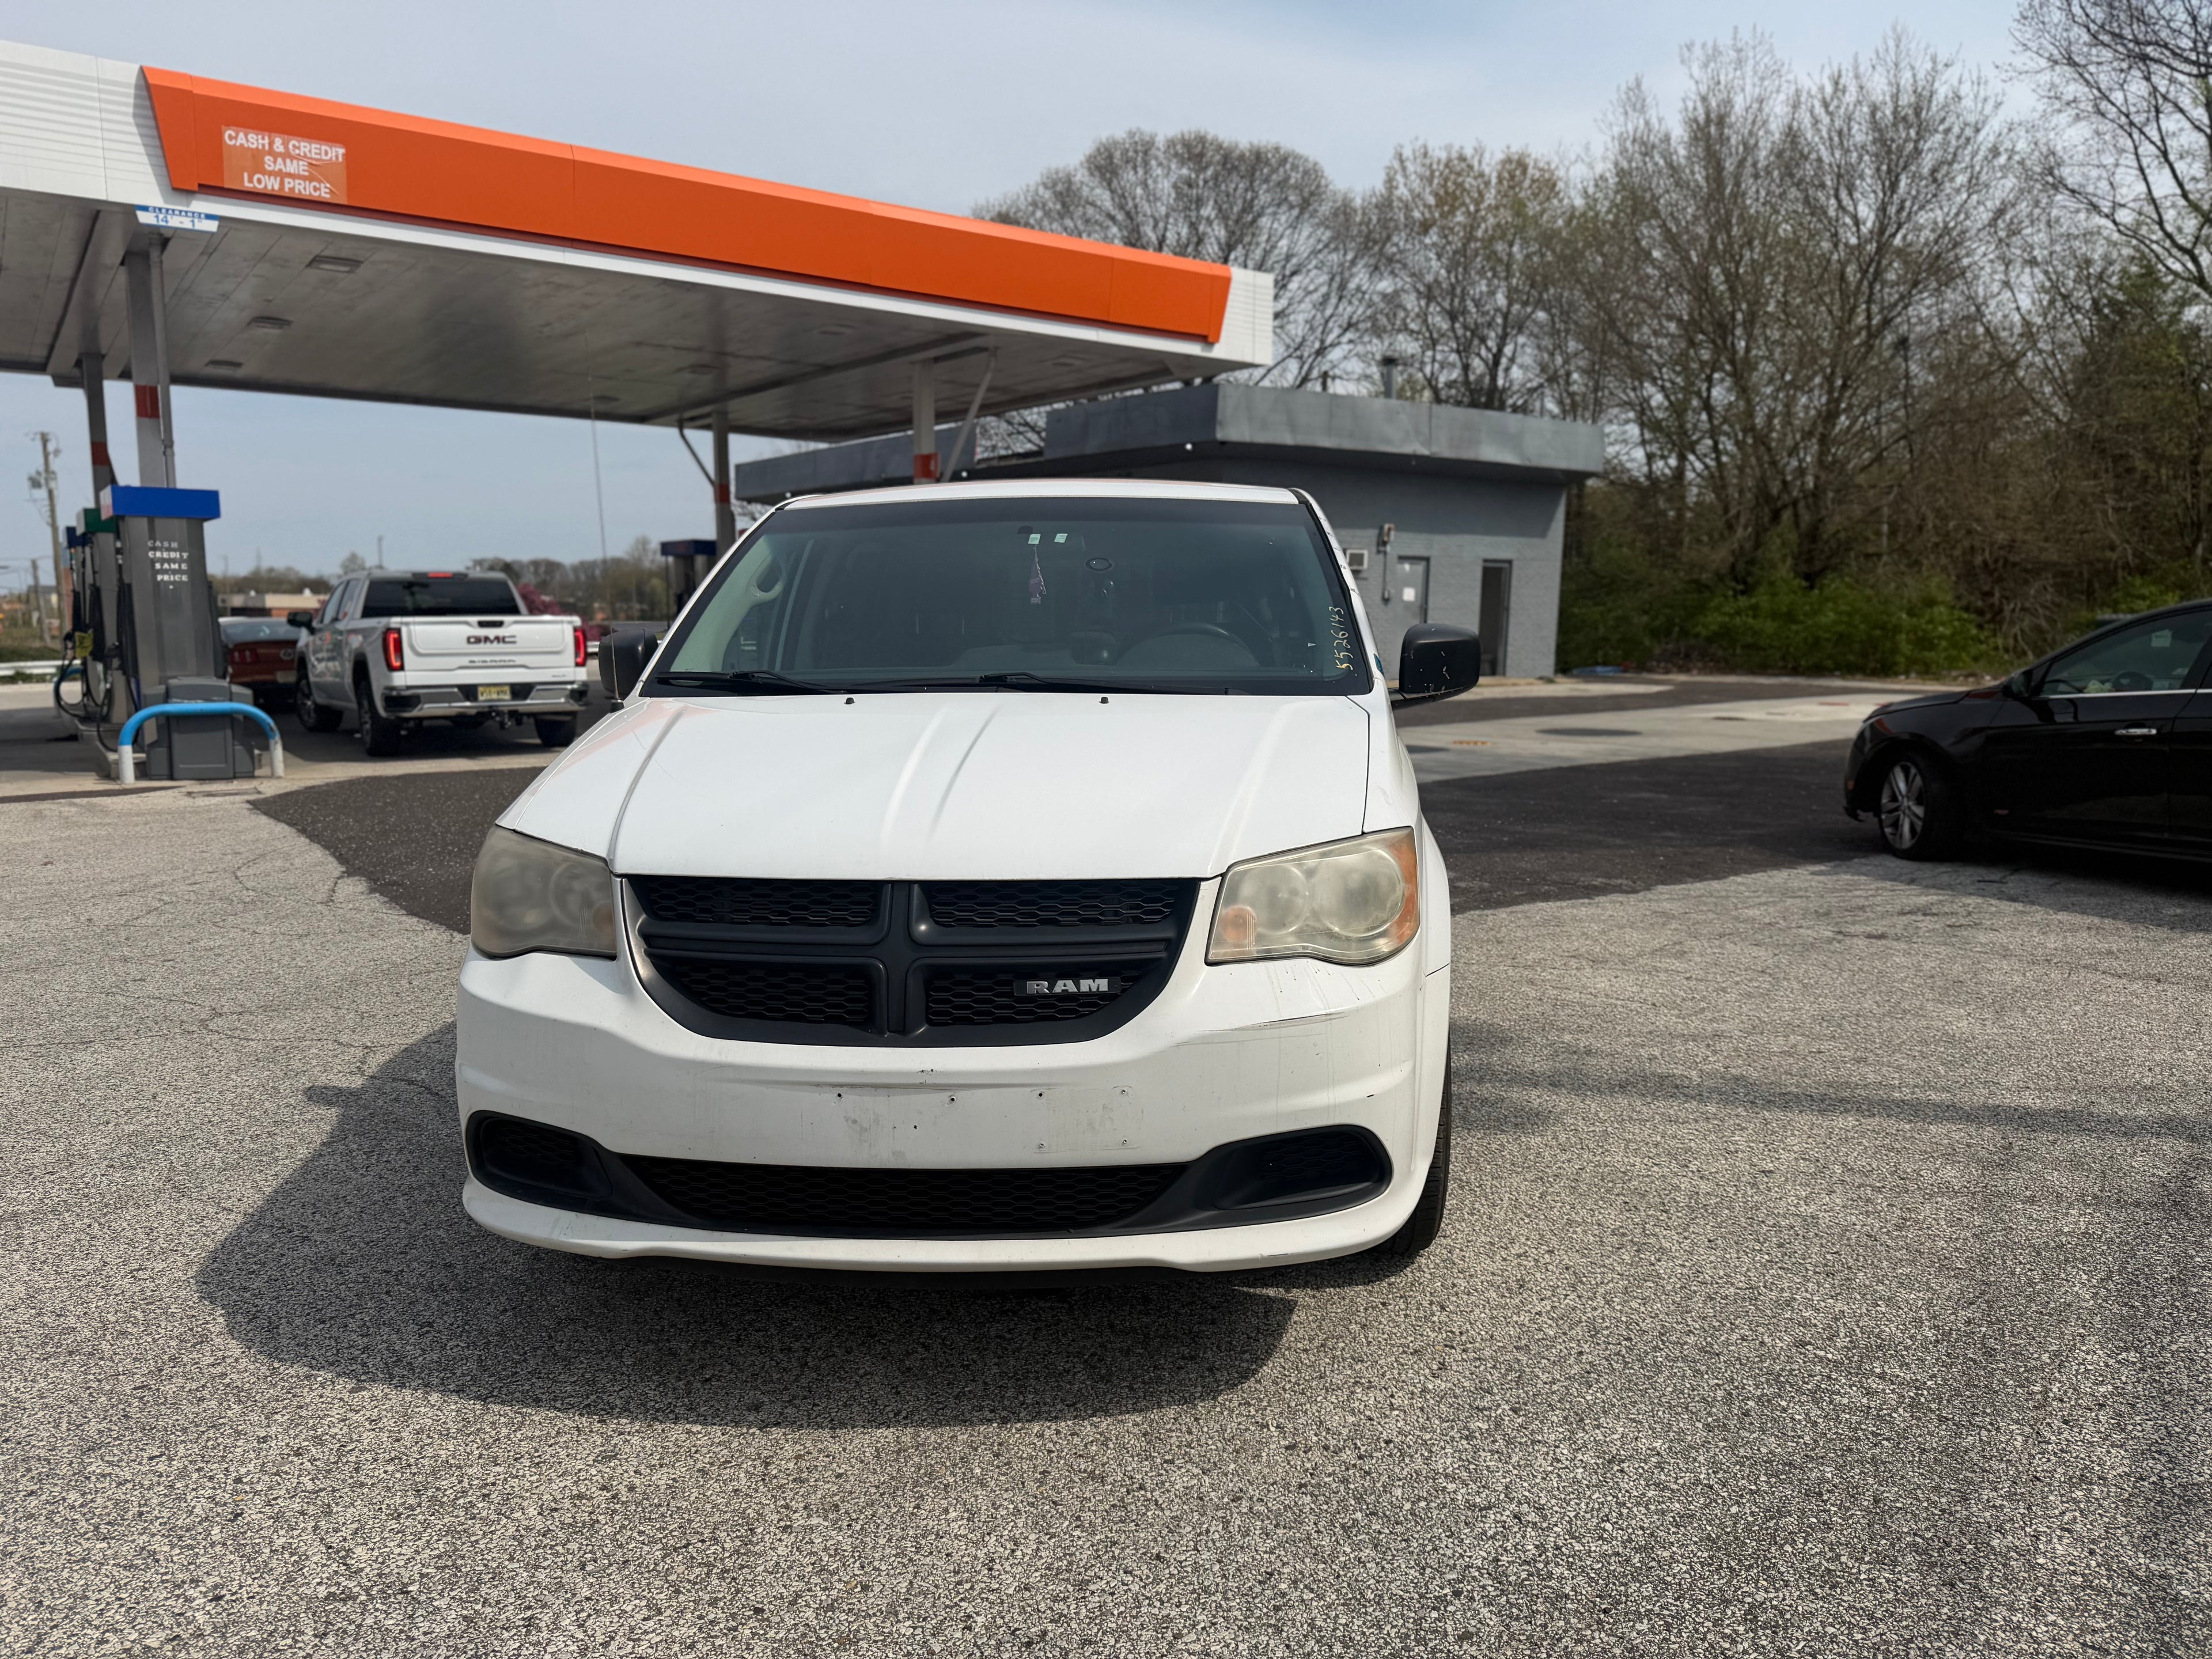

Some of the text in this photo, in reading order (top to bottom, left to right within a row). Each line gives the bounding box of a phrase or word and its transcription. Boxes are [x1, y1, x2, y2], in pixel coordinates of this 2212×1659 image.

[224, 130, 346, 162] CASH & CREDIT
[264, 155, 309, 175] SAME
[244, 172, 331, 198] LOW PRICE
[148, 206, 206, 219] CLEARANCE
[148, 551, 189, 559] CREDIT
[466, 635, 517, 645] GMC
[1328, 606, 1354, 671] 5526143
[1027, 978, 1109, 994] RAM
